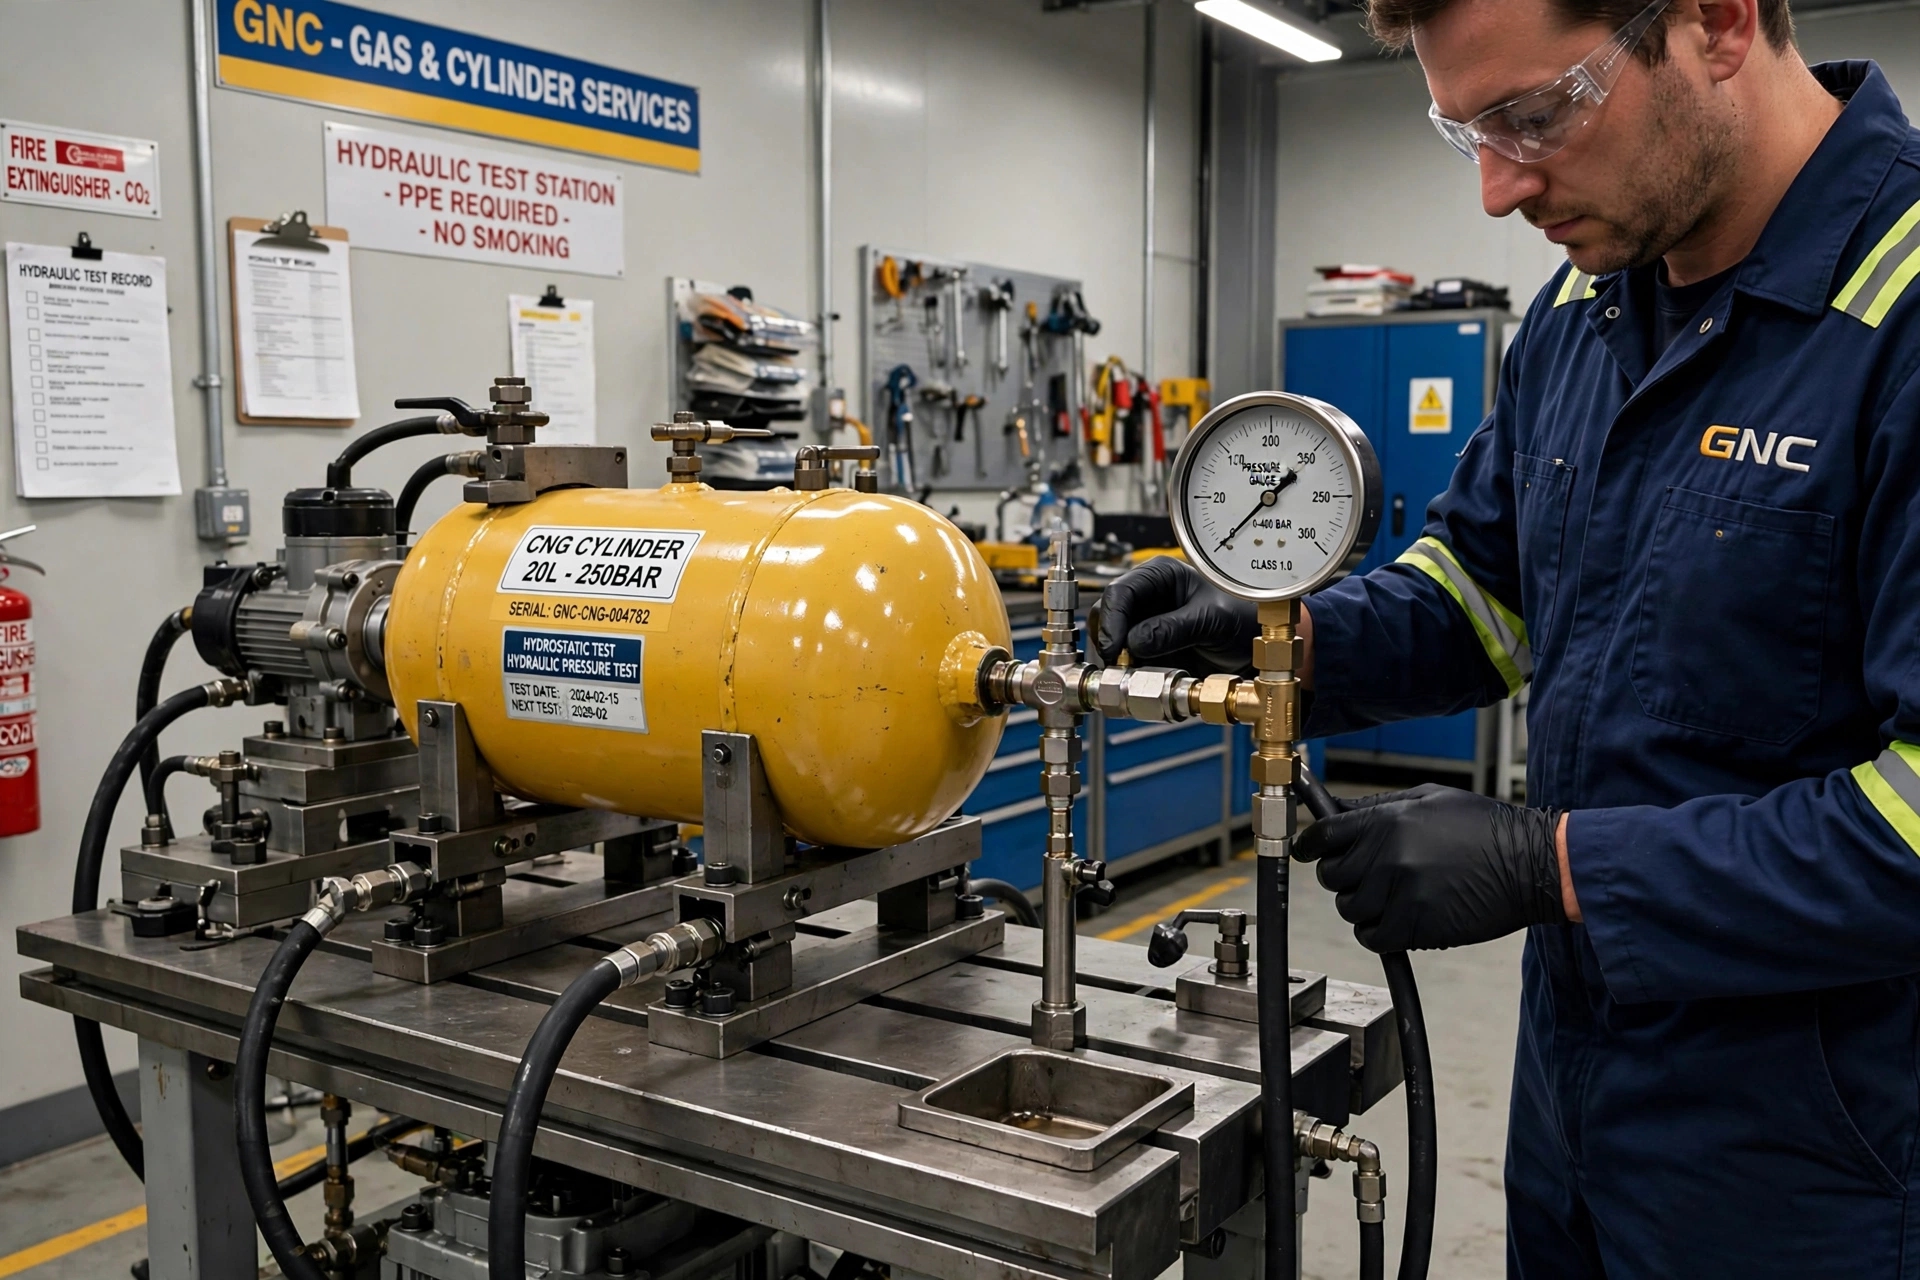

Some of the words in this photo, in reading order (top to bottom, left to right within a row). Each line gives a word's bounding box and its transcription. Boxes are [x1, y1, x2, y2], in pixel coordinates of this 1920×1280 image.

[233, 0, 323, 56] GNC
[350, 25, 413, 75] GAS
[419, 41, 441, 81] &
[446, 47, 576, 109] CYLINDER
[581, 78, 691, 134] SERVICES
[11, 134, 47, 162] FIRE
[7, 165, 111, 200] EXTINGUISHER
[337, 139, 471, 183] HYDRAULIC
[478, 162, 529, 191] TEST
[535, 172, 615, 206] STATION
[399, 183, 443, 211] PPE
[451, 190, 558, 226] REQUIRED
[434, 220, 466, 247] NO
[473, 225, 570, 259] SMOKING
[19, 264, 81, 282] HYDRAULIC
[84, 269, 108, 284] TEST
[111, 272, 153, 288] RECORD
[1262, 435, 1280, 447] 200
[1700, 424, 1818, 473] GNC
[1213, 492, 1226, 503] 20
[1312, 491, 1330, 503] 250
[1275, 518, 1292, 529] BAR
[1298, 527, 1316, 539] 300
[526, 535, 574, 555] CNG
[575, 536, 685, 560] CYLINDER
[522, 561, 557, 583] 20L
[575, 563, 662, 589] 250BAR
[1251, 559, 1277, 570] CLASS
[1280, 560, 1292, 571] 1.0
[509, 601, 551, 618] SERIAL:
[553, 603, 650, 625] GNC-CNG-004782
[523, 637, 590, 657] HYDROSTATIC
[592, 642, 616, 658] TEST
[507, 654, 559, 672] HYDRAULIC
[562, 658, 611, 677] PRESSURE
[613, 662, 638, 679] TEST
[509, 683, 531, 696] TEST
[533, 685, 560, 699] DATE:
[569, 688, 619, 705] 2024-02-15
[511, 699, 534, 712] NEXT
[536, 701, 562, 715] TEST:
